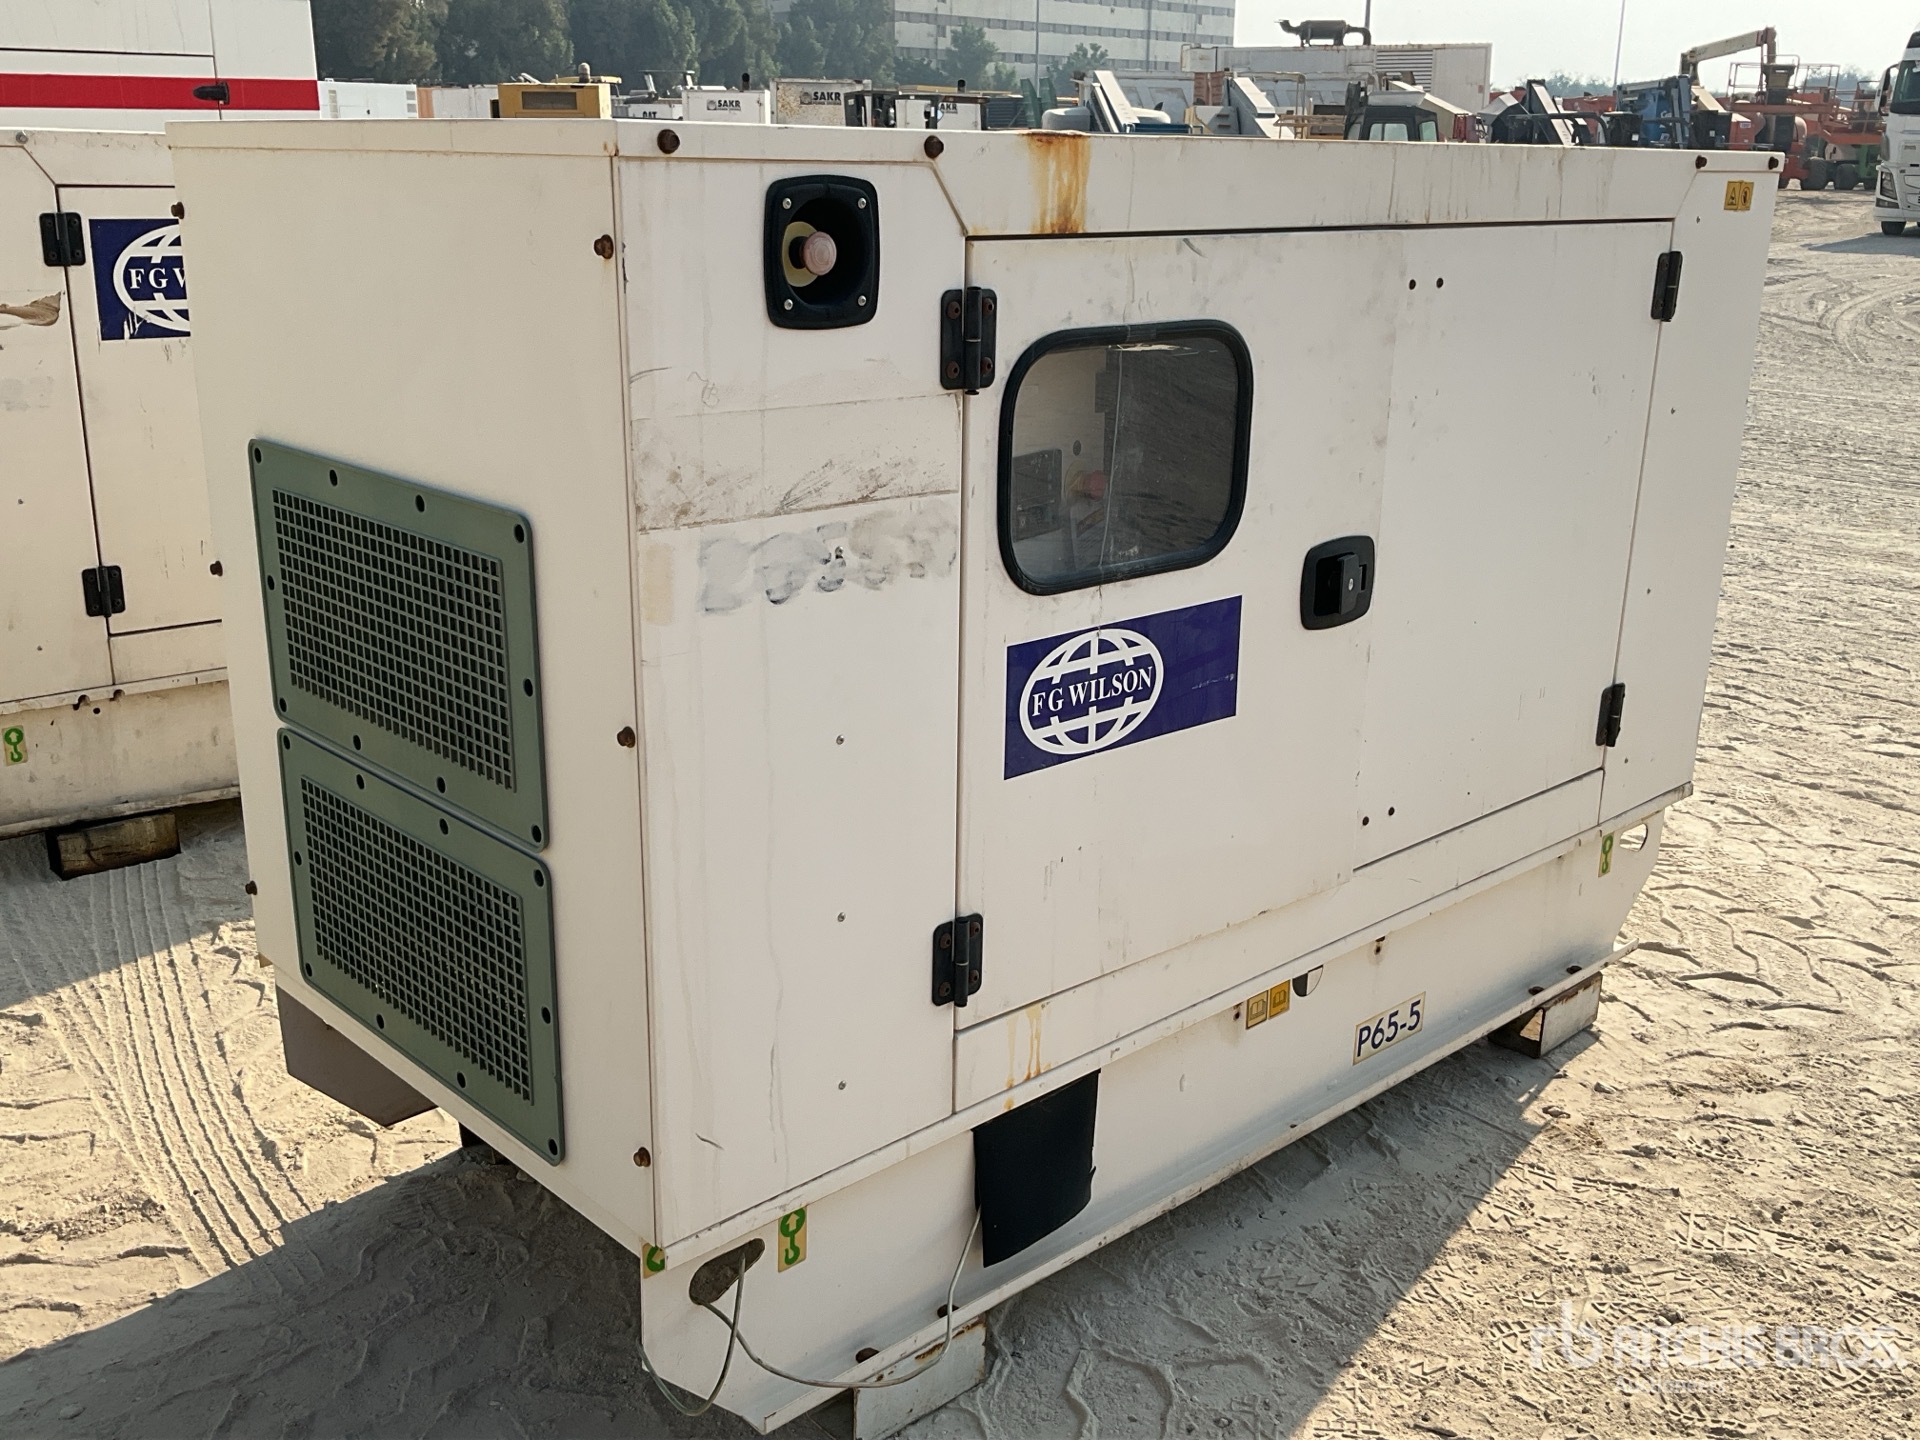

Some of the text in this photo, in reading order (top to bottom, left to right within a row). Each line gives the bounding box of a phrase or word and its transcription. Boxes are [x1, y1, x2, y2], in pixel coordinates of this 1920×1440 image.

[717, 99, 741, 108] SAKR
[812, 91, 842, 101] SAKR
[1068, 665, 1154, 707] WILSON
[1356, 999, 1422, 1058] P65-5
